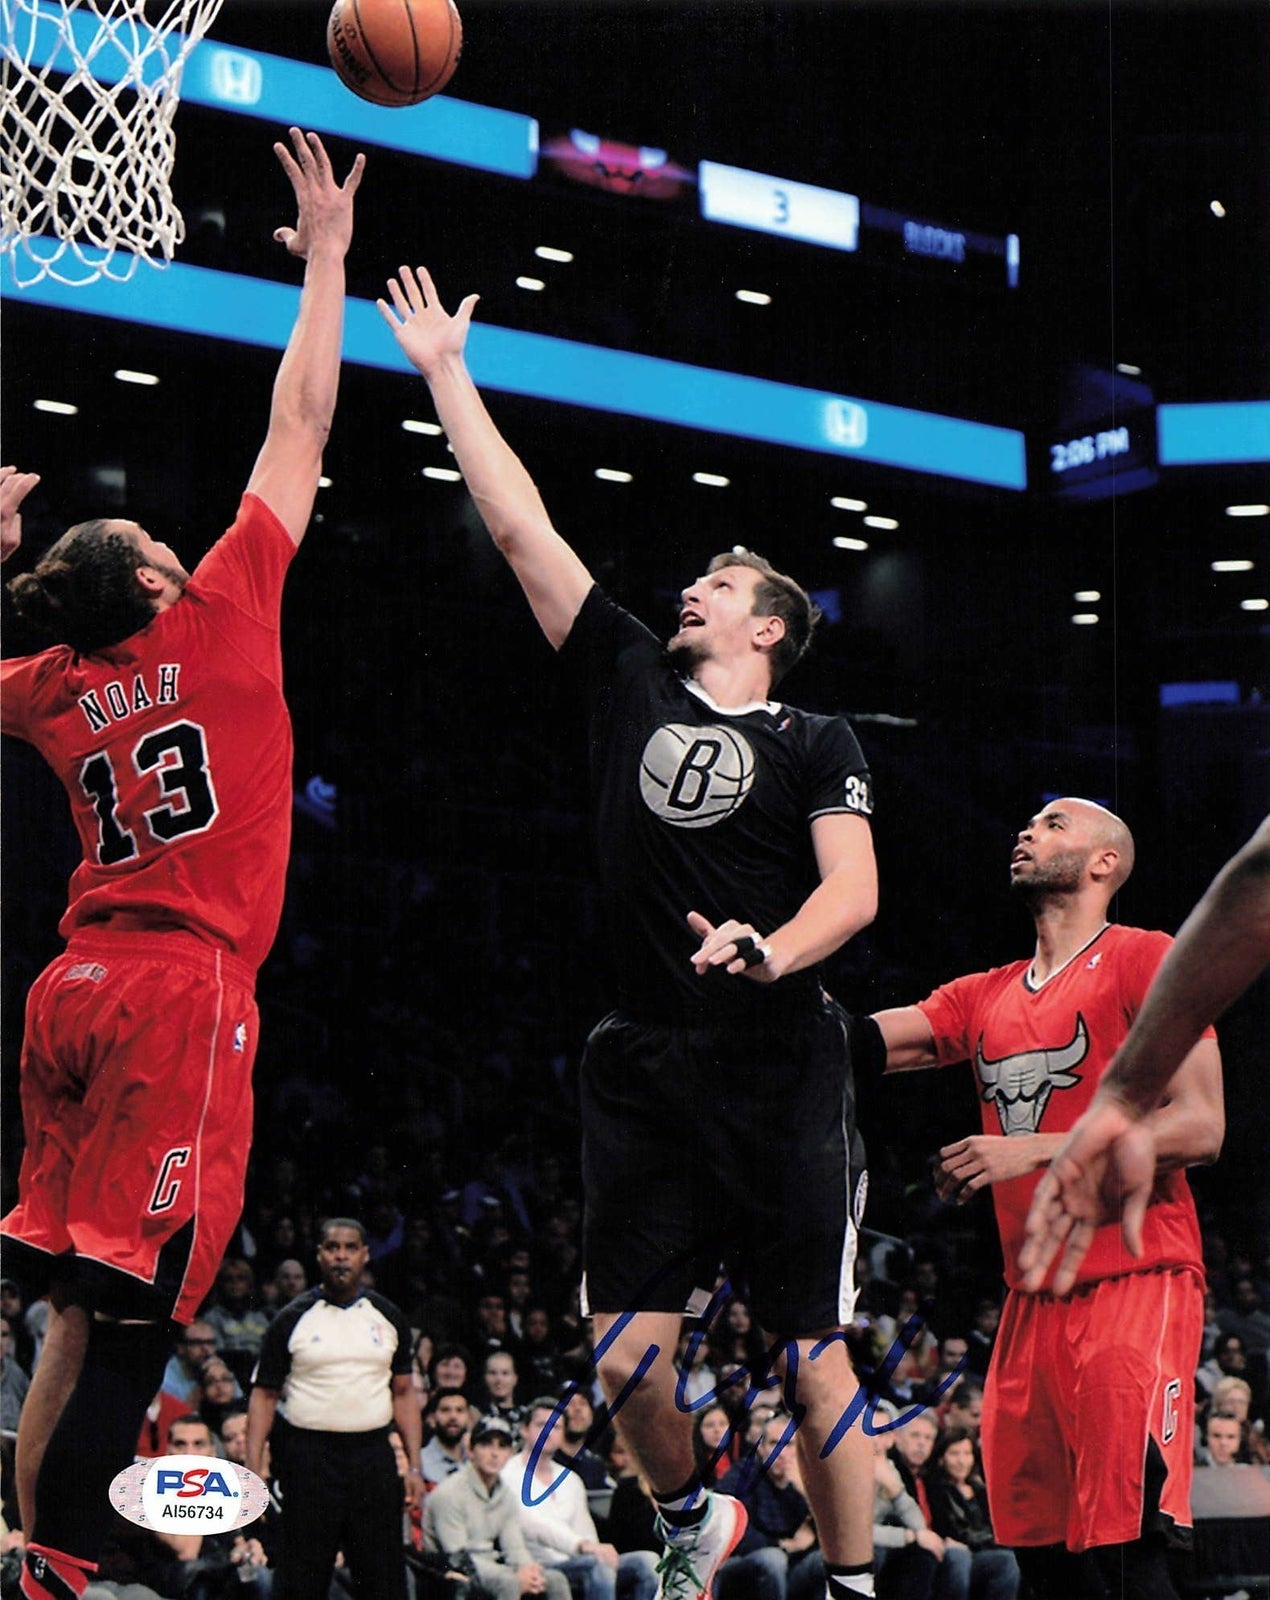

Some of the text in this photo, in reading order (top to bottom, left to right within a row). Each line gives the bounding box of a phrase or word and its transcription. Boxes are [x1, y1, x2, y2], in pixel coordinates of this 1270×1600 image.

[774, 190, 789, 223] 3
[1096, 426, 1130, 459] PM
[79, 664, 180, 733] NOAH
[79, 718, 220, 865] 13
[667, 739, 722, 811] B
[148, 1146, 192, 1214] C
